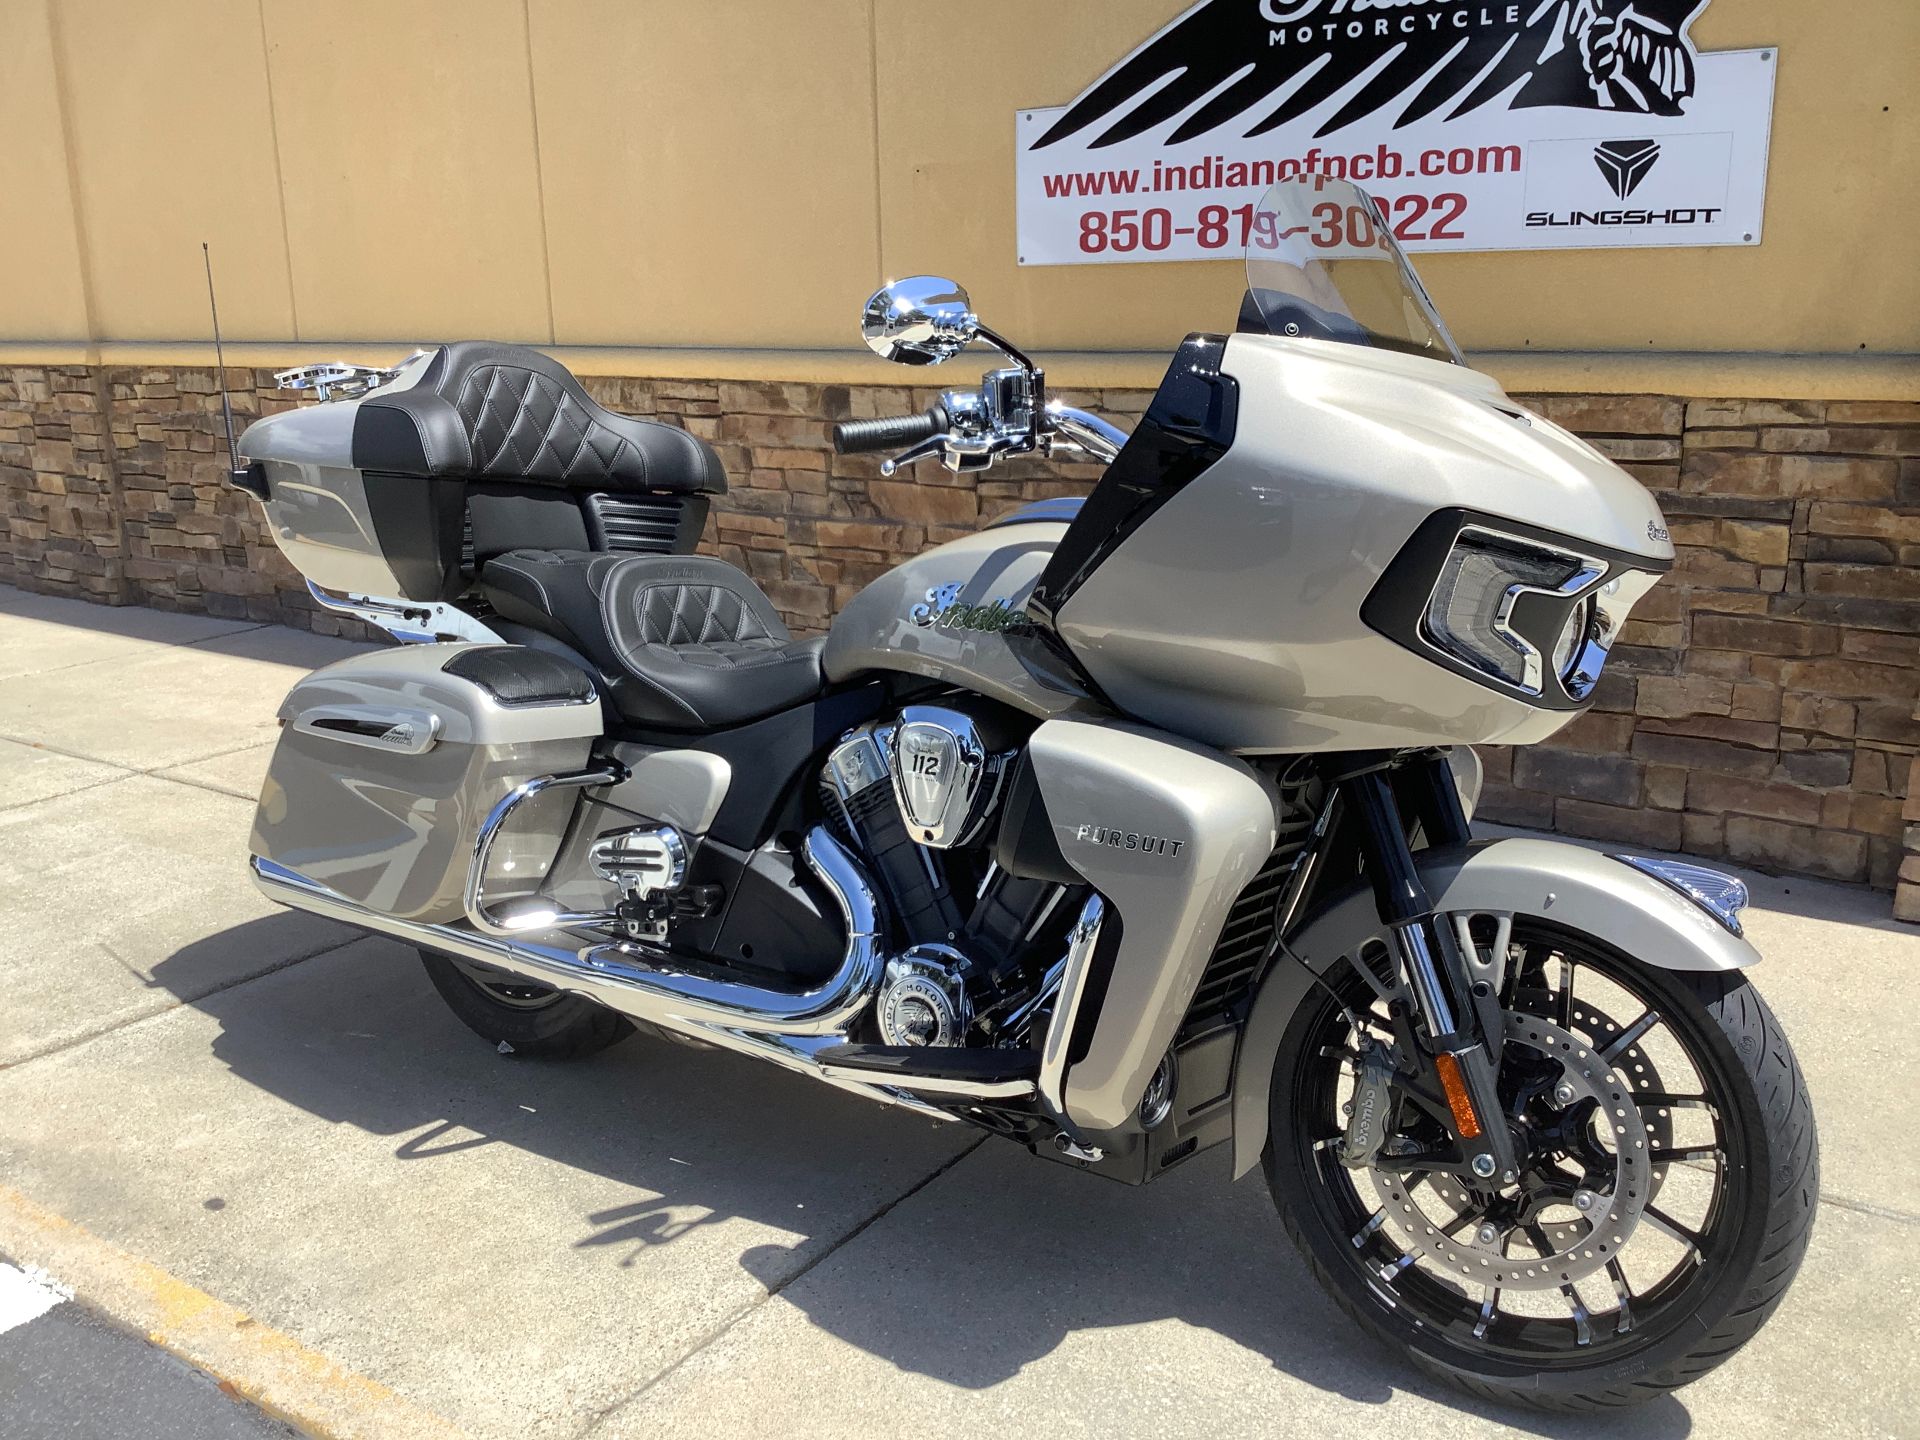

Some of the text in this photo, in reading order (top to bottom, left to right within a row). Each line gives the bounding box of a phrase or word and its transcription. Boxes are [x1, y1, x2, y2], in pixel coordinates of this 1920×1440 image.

[1268, 5, 1519, 47] MOTORCYCLE
[1525, 208, 1722, 227] SLINGSHOT
[912, 754, 939, 776] 112
[1076, 823, 1185, 858] PURSUIT
[1354, 1089, 1376, 1146] brembo
